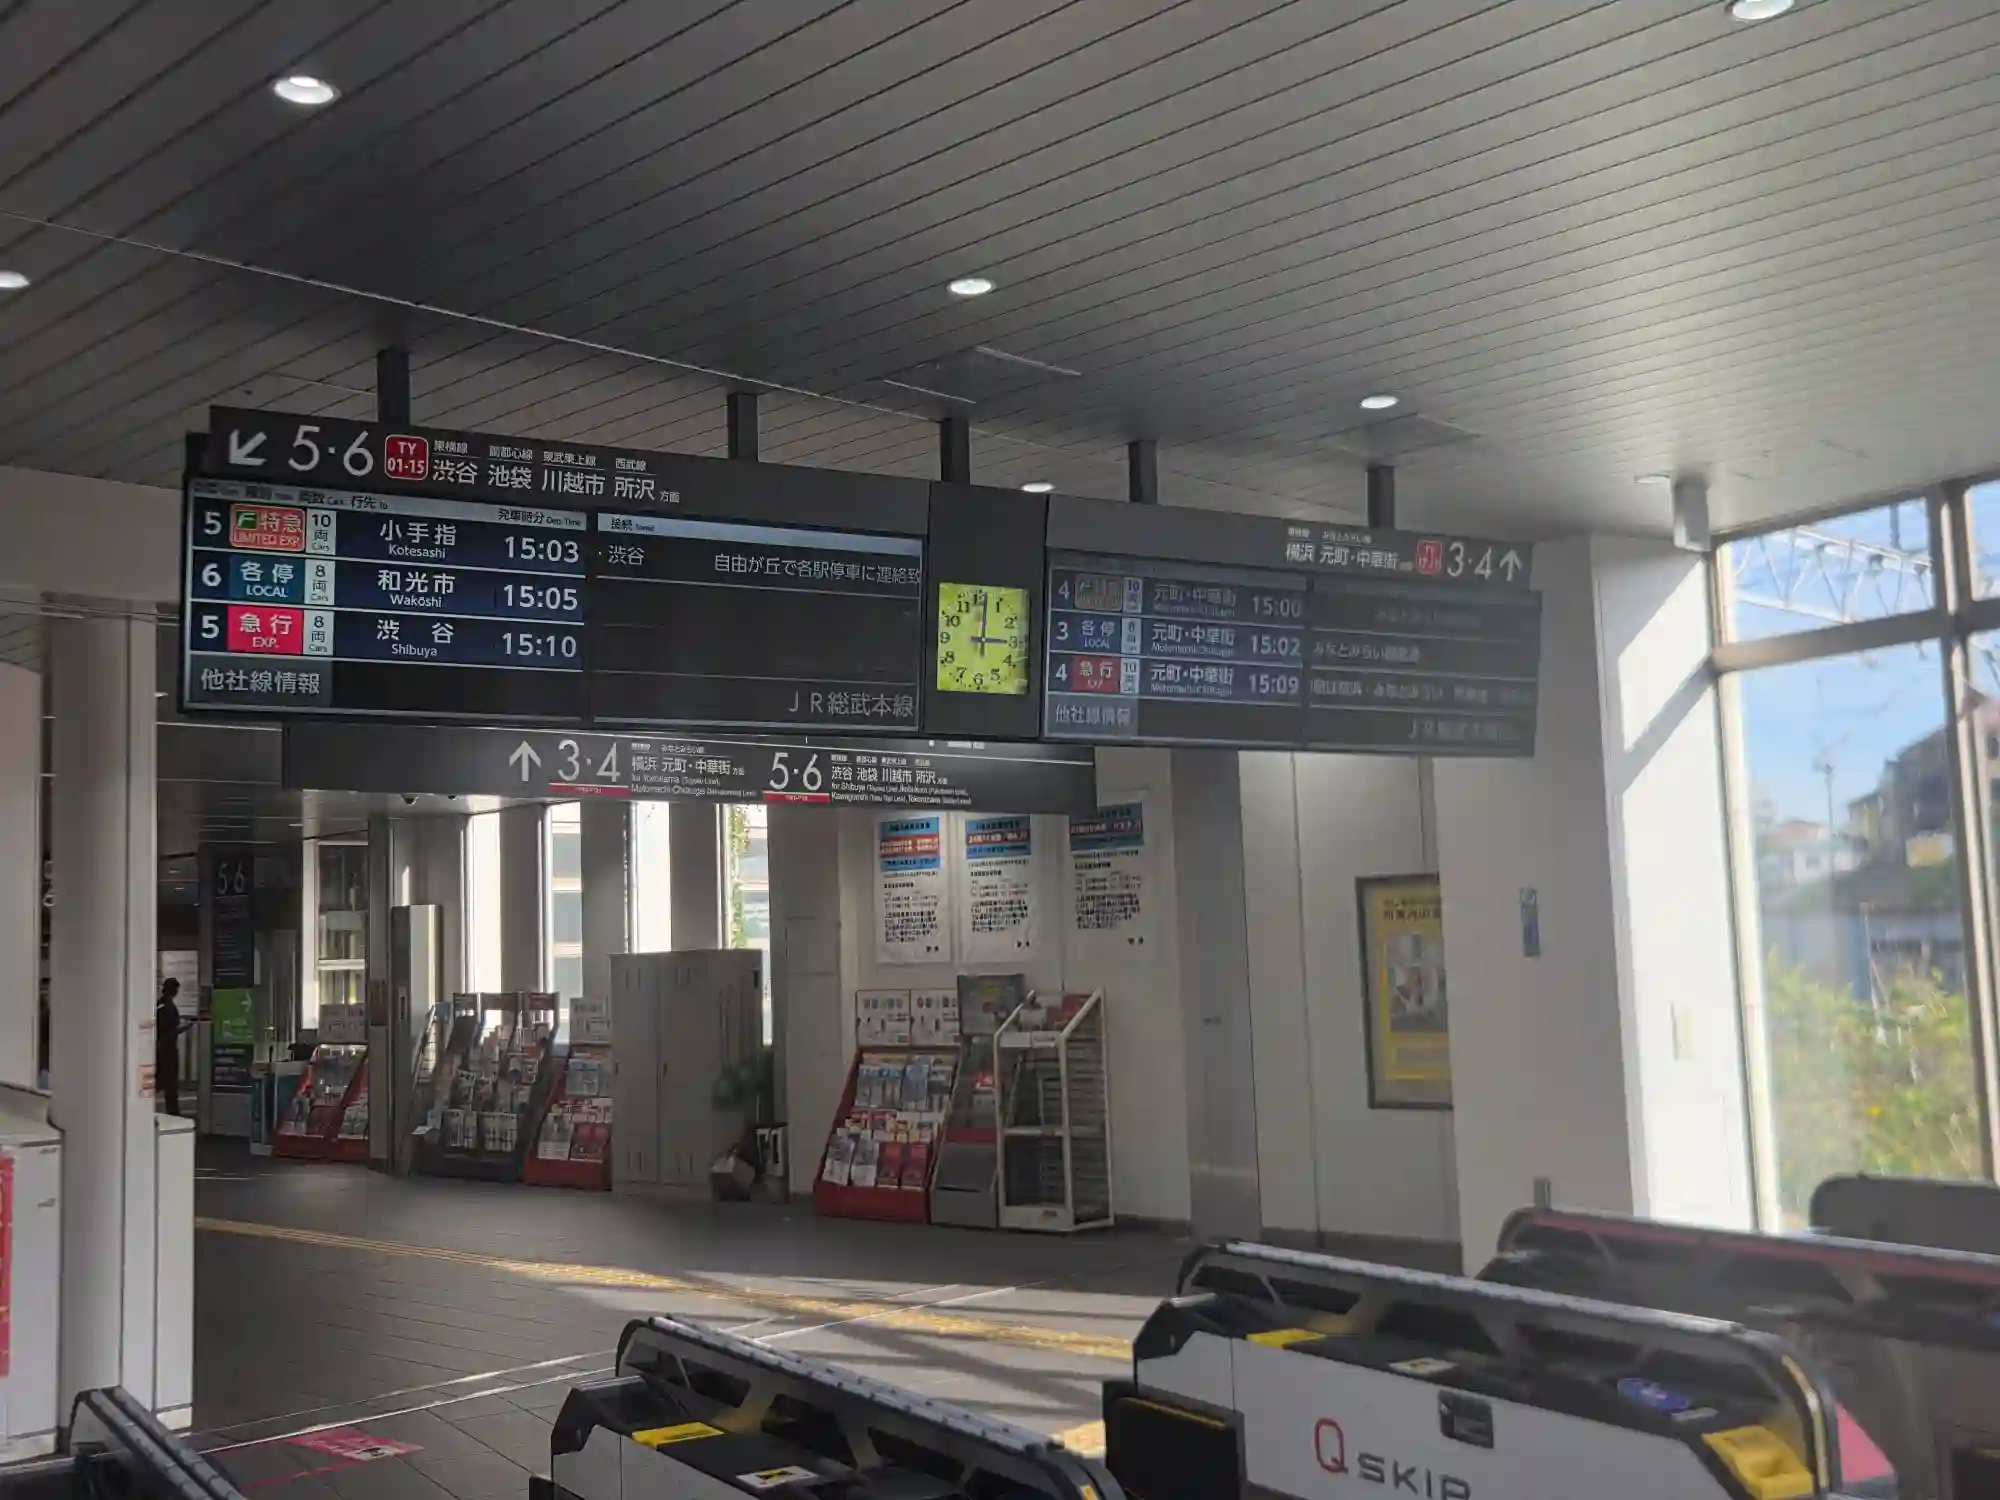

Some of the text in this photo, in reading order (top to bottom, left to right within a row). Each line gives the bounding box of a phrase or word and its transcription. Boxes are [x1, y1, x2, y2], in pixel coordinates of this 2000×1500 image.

[398, 441, 417, 456] TY
[387, 458, 425, 475] 01-15
[432, 460, 478, 485] 渋谷
[488, 465, 532, 490] 池袋
[541, 469, 605, 496] 川越市
[614, 476, 656, 501] 所沢
[203, 511, 222, 535] 5
[311, 513, 331, 527] 10
[314, 531, 328, 542] 両
[379, 519, 457, 546] 小手指
[389, 543, 446, 559] Kotesashi
[504, 536, 579, 563] 15:03
[608, 544, 645, 565] 渋谷
[1286, 543, 1314, 563] 横浜
[1320, 545, 1398, 570] 元町・中華街
[202, 563, 222, 587] 6
[240, 561, 294, 584] 各停
[315, 564, 325, 577] 8
[246, 585, 288, 597] LOCAL
[312, 580, 326, 592] 両
[378, 570, 456, 595] 和光市
[1058, 580, 1070, 598] 4
[1127, 579, 1140, 592] 10
[503, 584, 578, 611] 15:05
[1251, 594, 1301, 618] 15:00
[200, 615, 219, 639] 5
[239, 612, 292, 635] 急行
[314, 615, 324, 628] 8
[945, 615, 960, 627] 10
[1005, 617, 1015, 629] 2
[1081, 620, 1115, 637] 各停
[311, 630, 325, 643] 両
[940, 632, 951, 643] 9
[1056, 622, 1069, 640] 3
[1152, 623, 1236, 647] 元町・中華街
[252, 636, 279, 648] EXP.
[391, 643, 438, 659] Shibuya
[502, 632, 577, 658] 15:10
[1009, 636, 1018, 648] 3
[1250, 634, 1300, 657] 15:02
[945, 651, 955, 663] 8
[1003, 654, 1012, 667] 4
[956, 667, 966, 678] 7
[991, 668, 1000, 680] 5
[1055, 663, 1068, 682] 4
[1079, 660, 1114, 679] 急行
[1150, 665, 1235, 685] 元町・中華街
[201, 668, 320, 694] 他社線情報
[1248, 674, 1300, 695] 15:09
[631, 756, 658, 771] 横浜
[662, 757, 731, 775] 元町・中華街
[831, 766, 853, 781] 渋谷
[857, 767, 878, 782] 池袋
[882, 768, 912, 783] 川越市
[915, 770, 936, 785] 所沢
